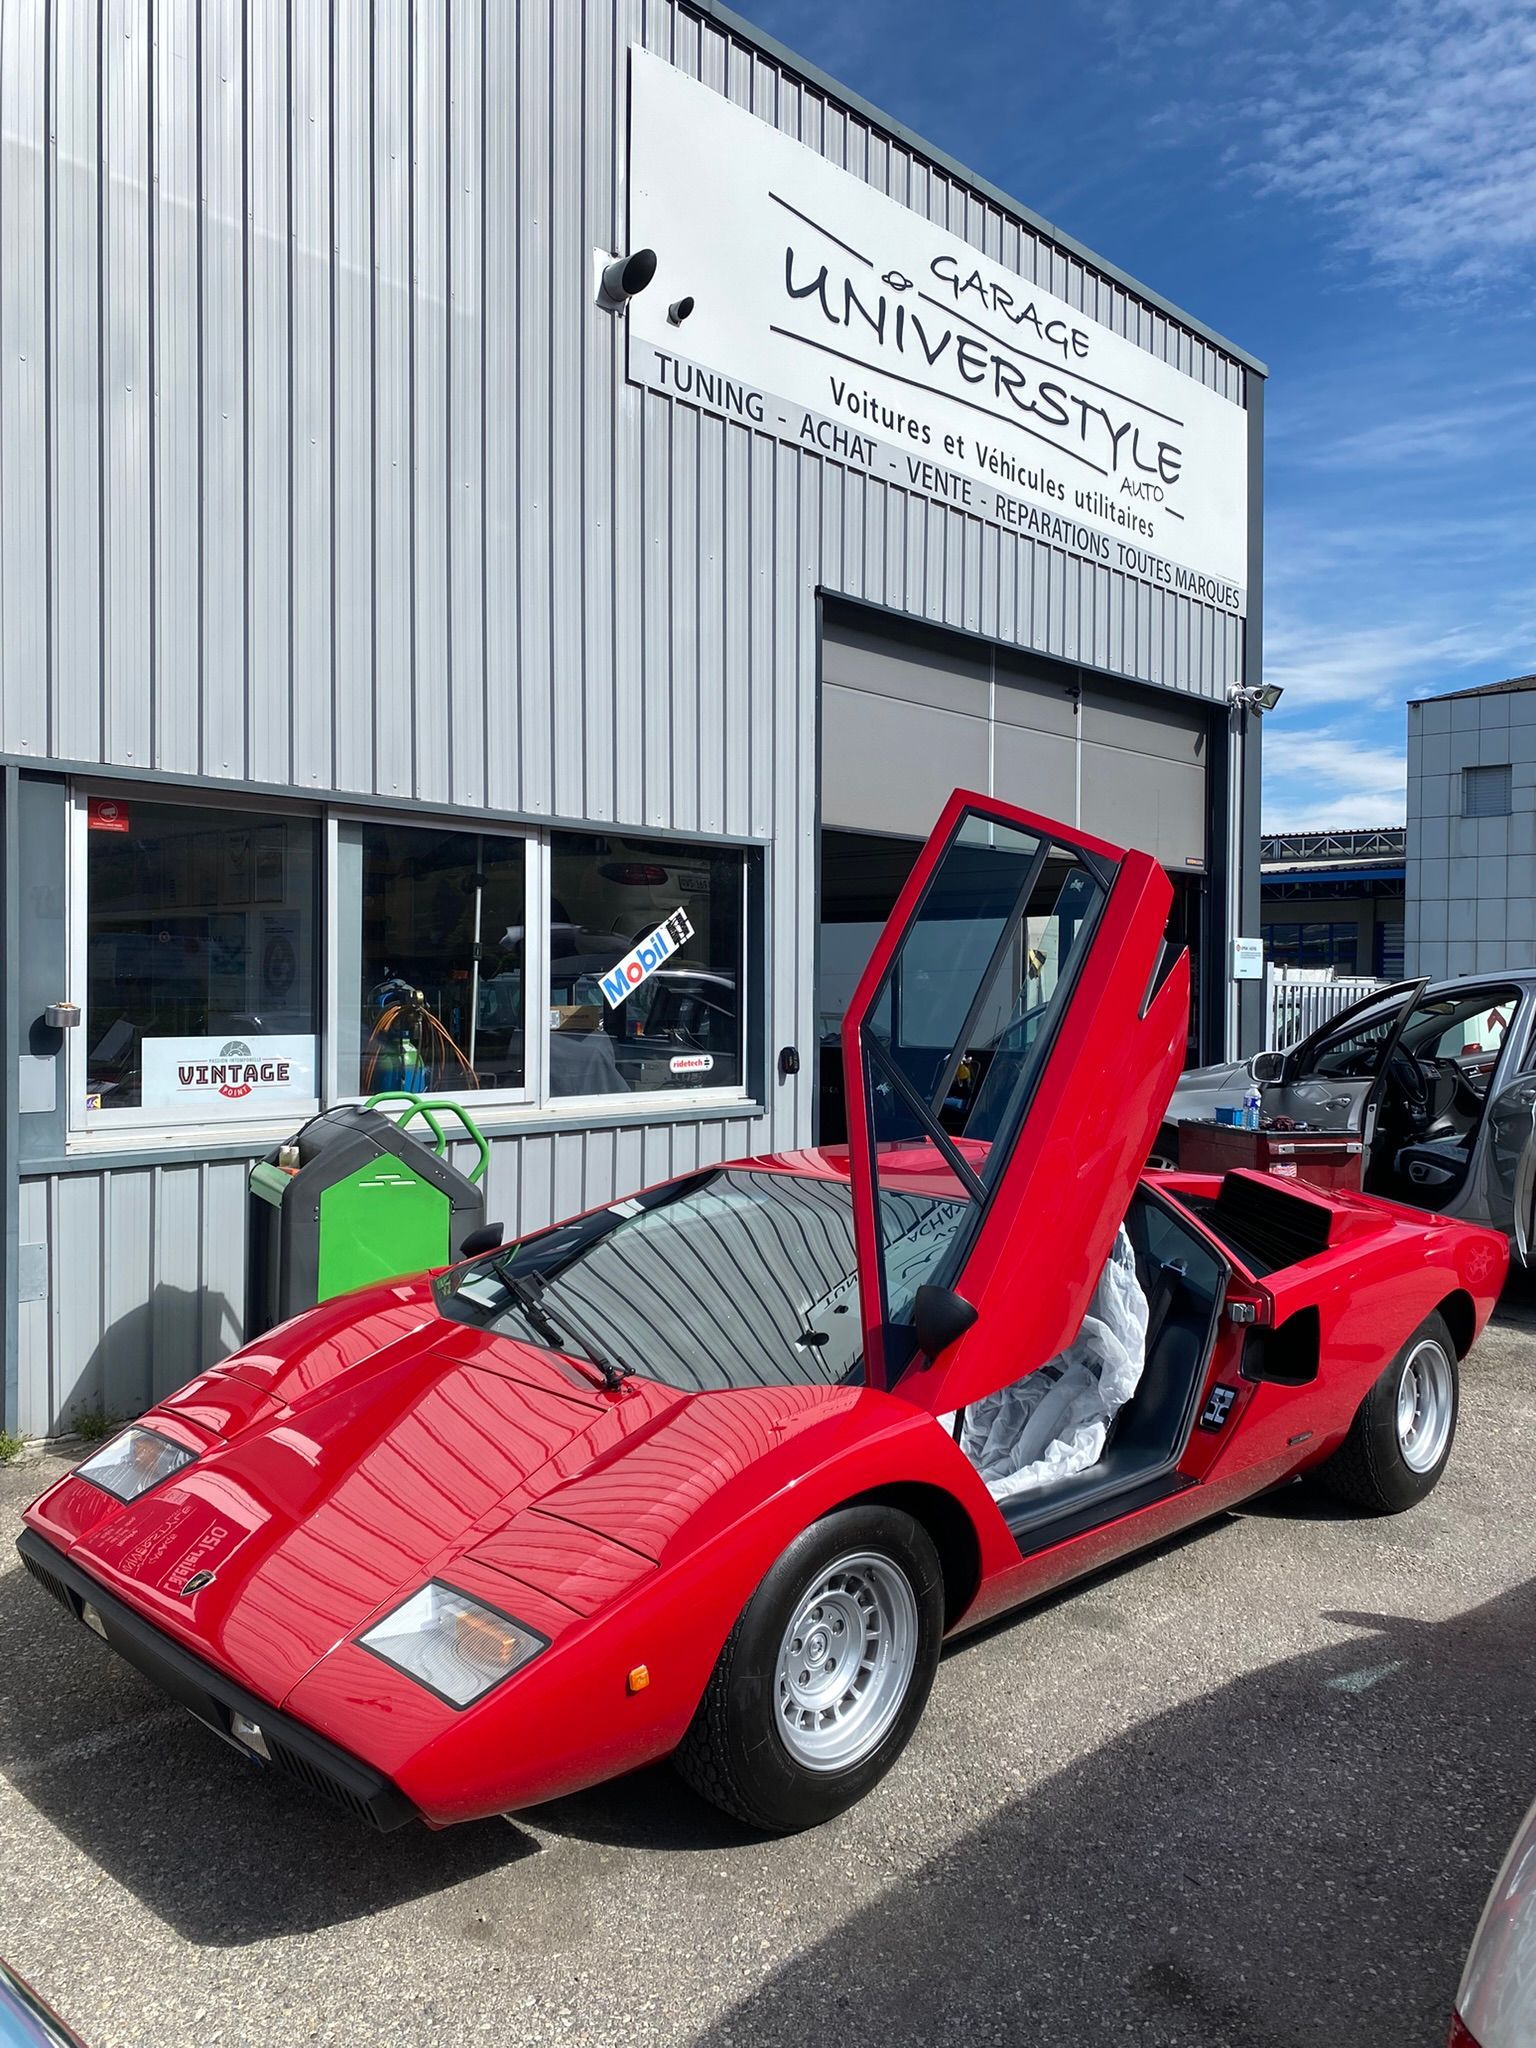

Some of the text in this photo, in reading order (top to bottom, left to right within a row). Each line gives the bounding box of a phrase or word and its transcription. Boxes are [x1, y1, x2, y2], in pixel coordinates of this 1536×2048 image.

[929, 255, 1090, 359] GARAGE
[654, 351, 764, 422] TUNING
[800, 413, 877, 467] ACHAT
[906, 456, 972, 506] VENTE
[995, 493, 1109, 559] REPARATIONS
[1117, 543, 1172, 584] TOUTES
[1175, 567, 1240, 609] MARQUES
[830, 376, 1154, 538] Voitures et Véhicules utilitaires
[1120, 477, 1164, 502] AUTO
[602, 931, 669, 1004] Mobil
[178, 1063, 290, 1085] VINTAGE
[222, 1085, 249, 1097] POINT
[673, 1059, 703, 1068] ridetech
[775, 1519, 831, 1580] MICHELIN
